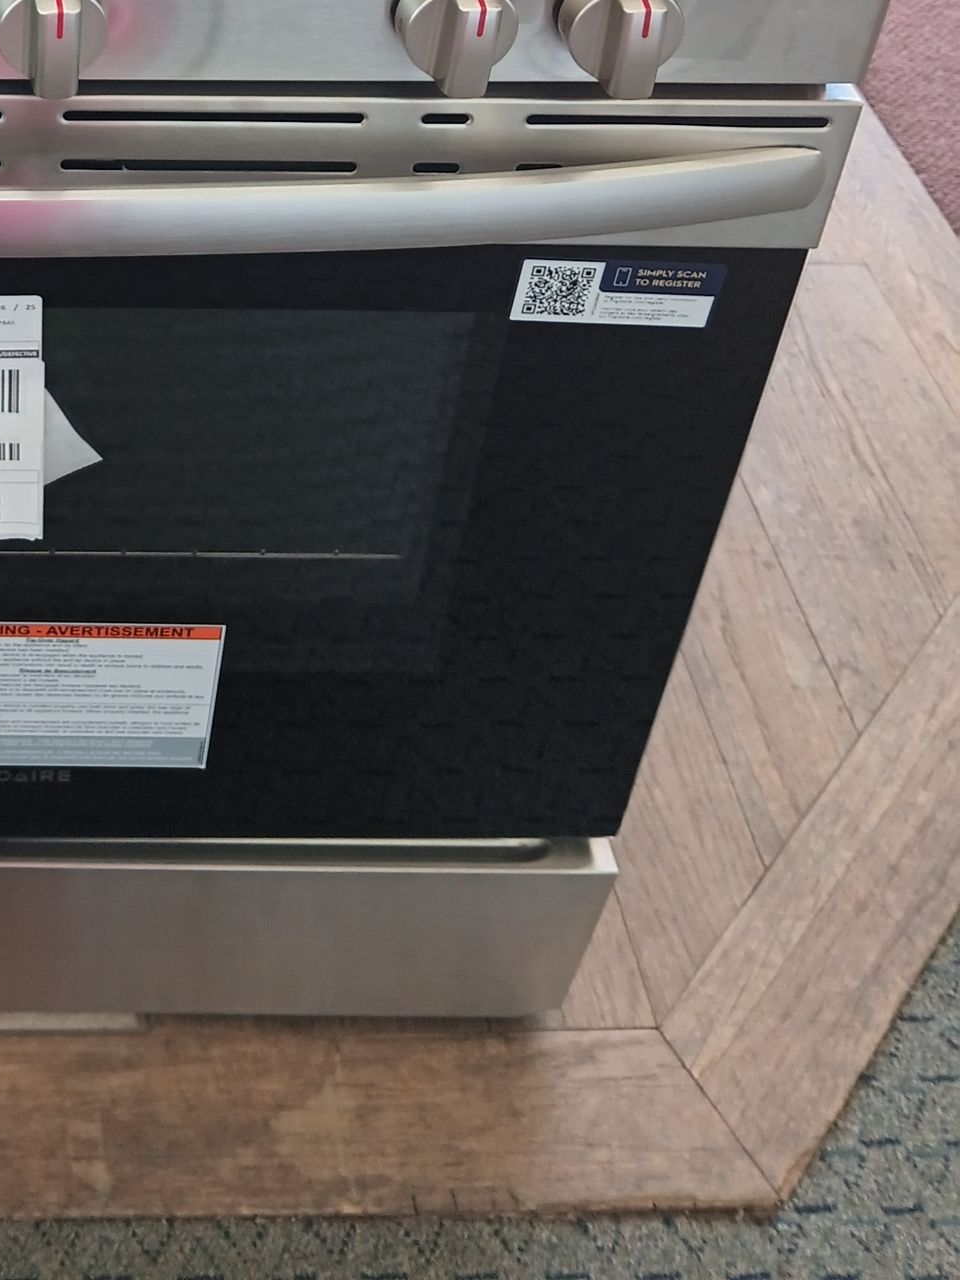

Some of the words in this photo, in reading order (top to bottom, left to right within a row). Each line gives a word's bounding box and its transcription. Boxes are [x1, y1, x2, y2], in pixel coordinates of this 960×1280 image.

[637, 268, 675, 278] SIMPLY
[676, 270, 707, 279] SCAN
[635, 278, 651, 287] TO
[652, 279, 702, 289] REGISTER
[46, 625, 196, 637] AVERTISSEMENT
